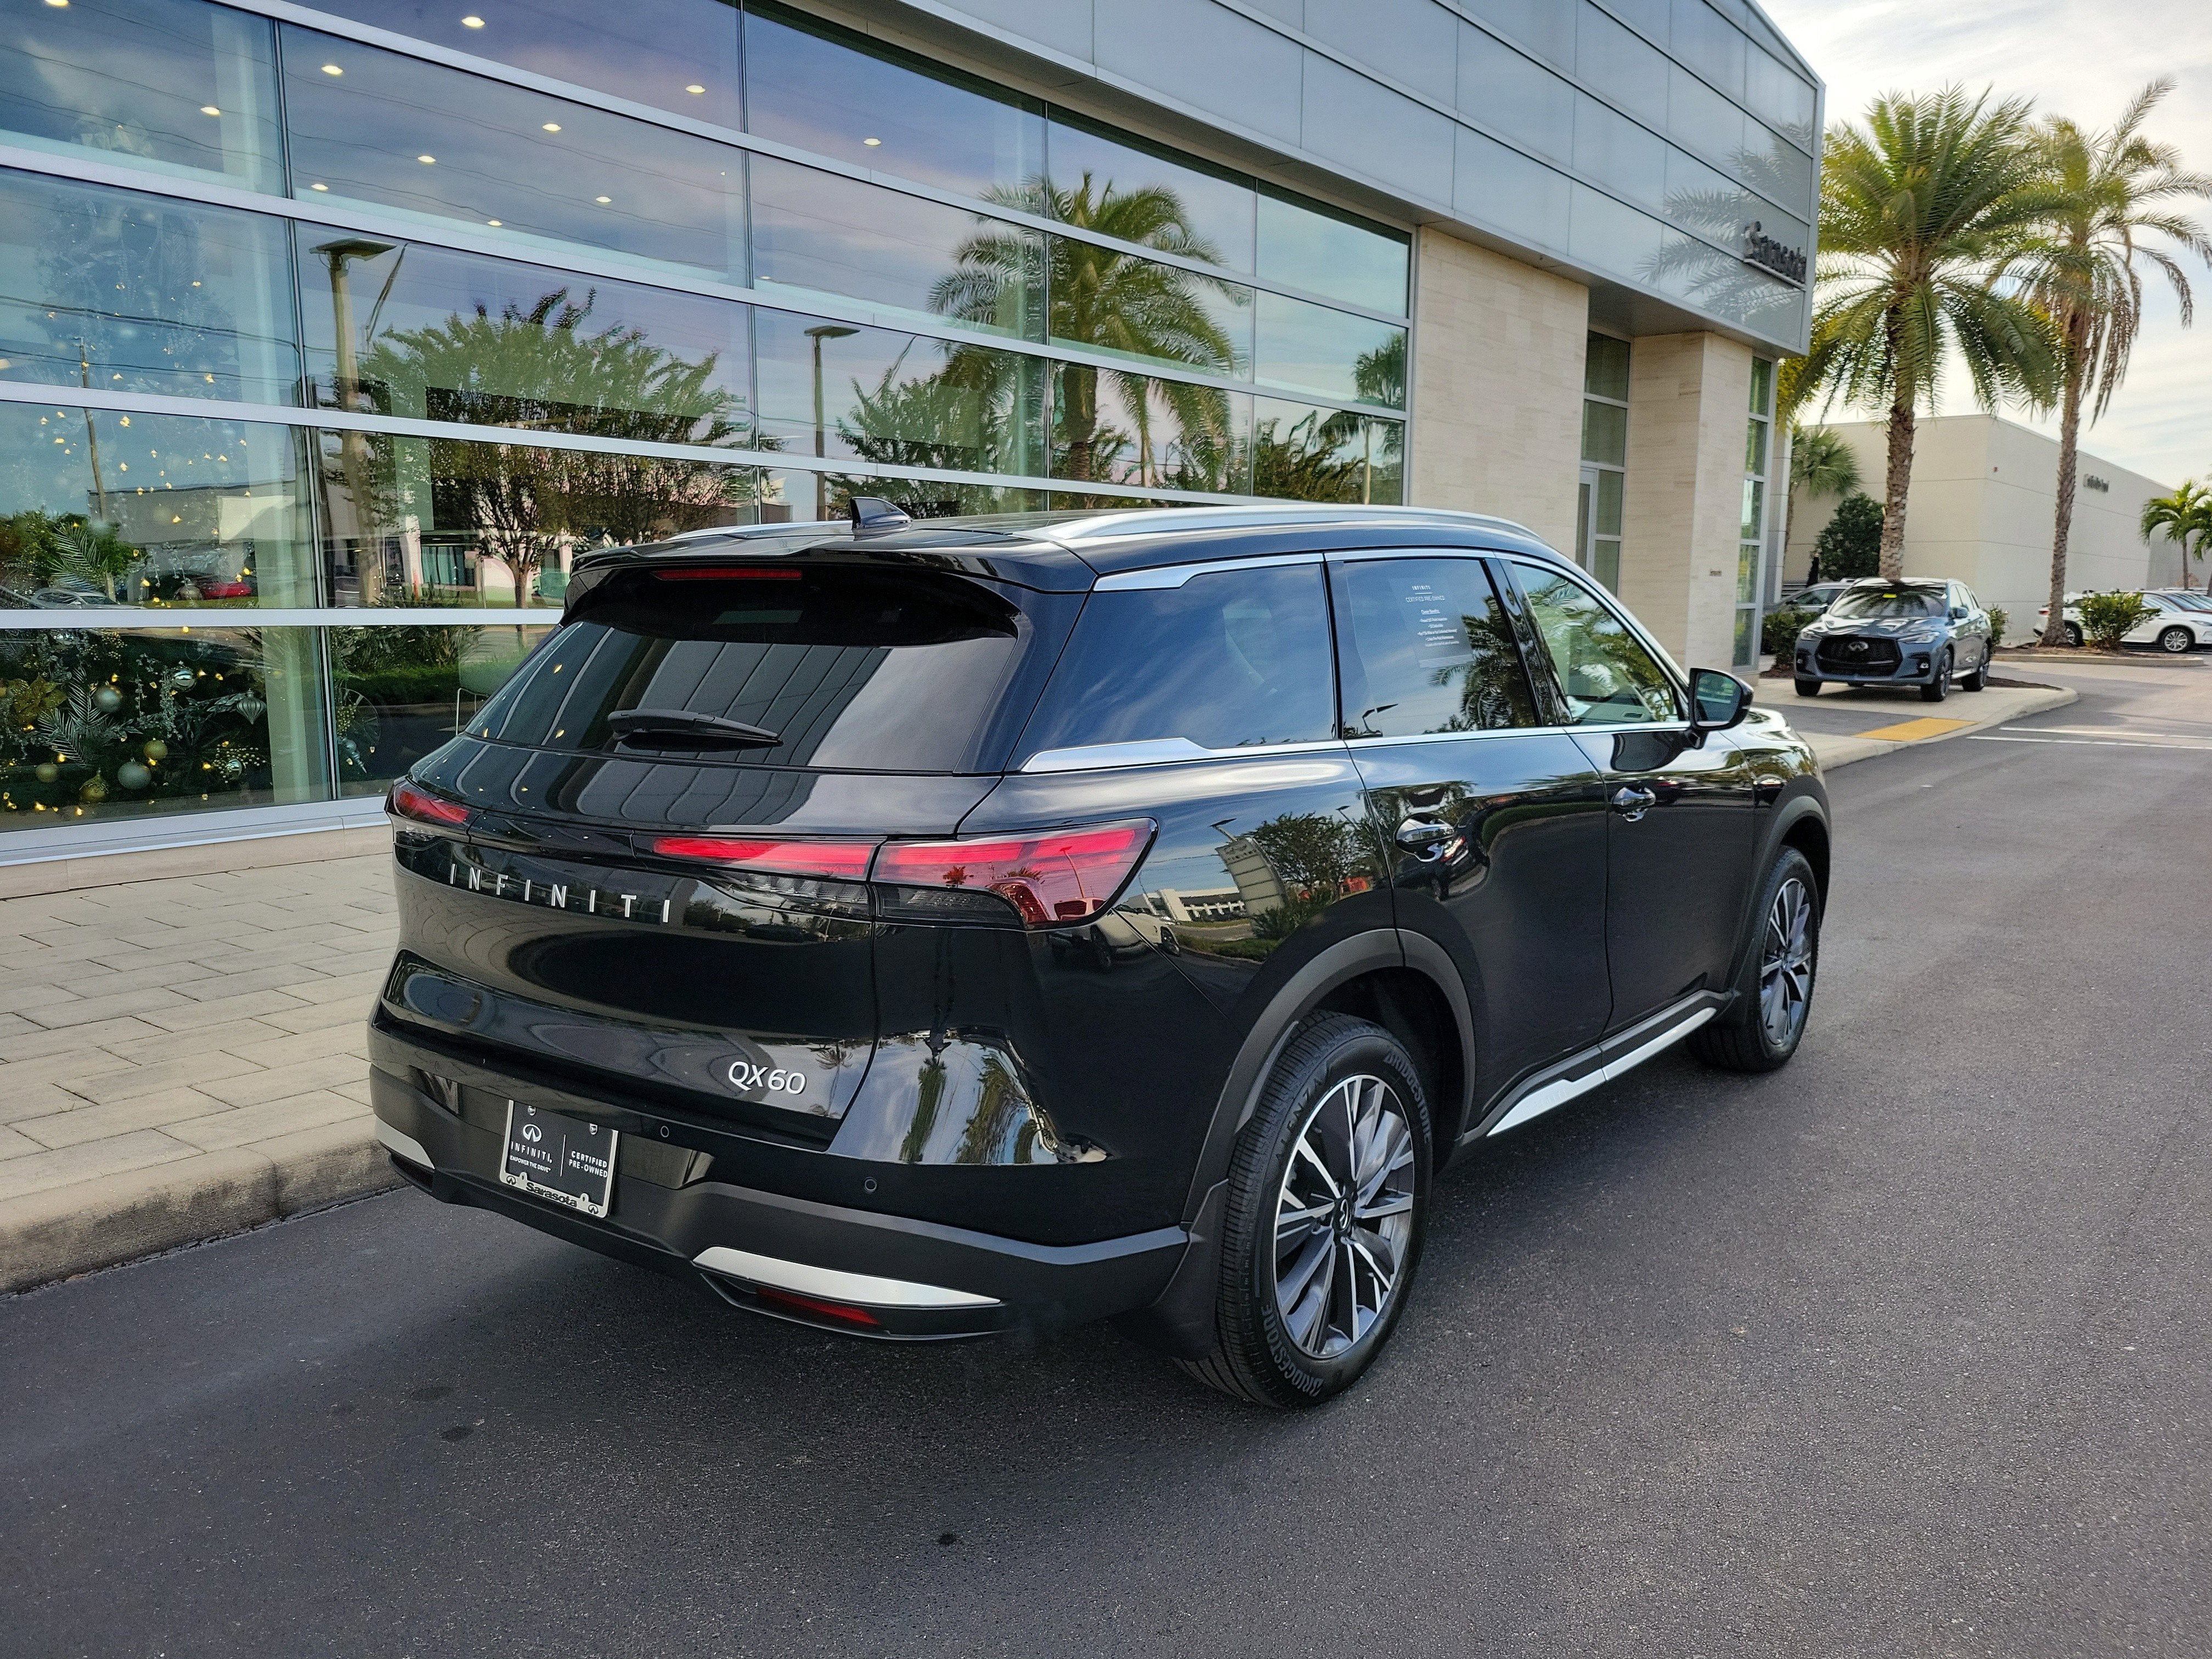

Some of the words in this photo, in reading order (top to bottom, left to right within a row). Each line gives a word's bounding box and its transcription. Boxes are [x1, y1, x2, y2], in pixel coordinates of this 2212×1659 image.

[450, 863, 670, 923] INFINITI
[728, 1061, 806, 1095] QX60
[509, 1155, 530, 1166] EMPOWER
[569, 1159, 608, 1178] PRE-OWNED
[571, 1150, 608, 1168] CERTIFIED
[526, 1182, 578, 1207] Sarasota
[1261, 1304, 1324, 1398] BRIDGESTONE
